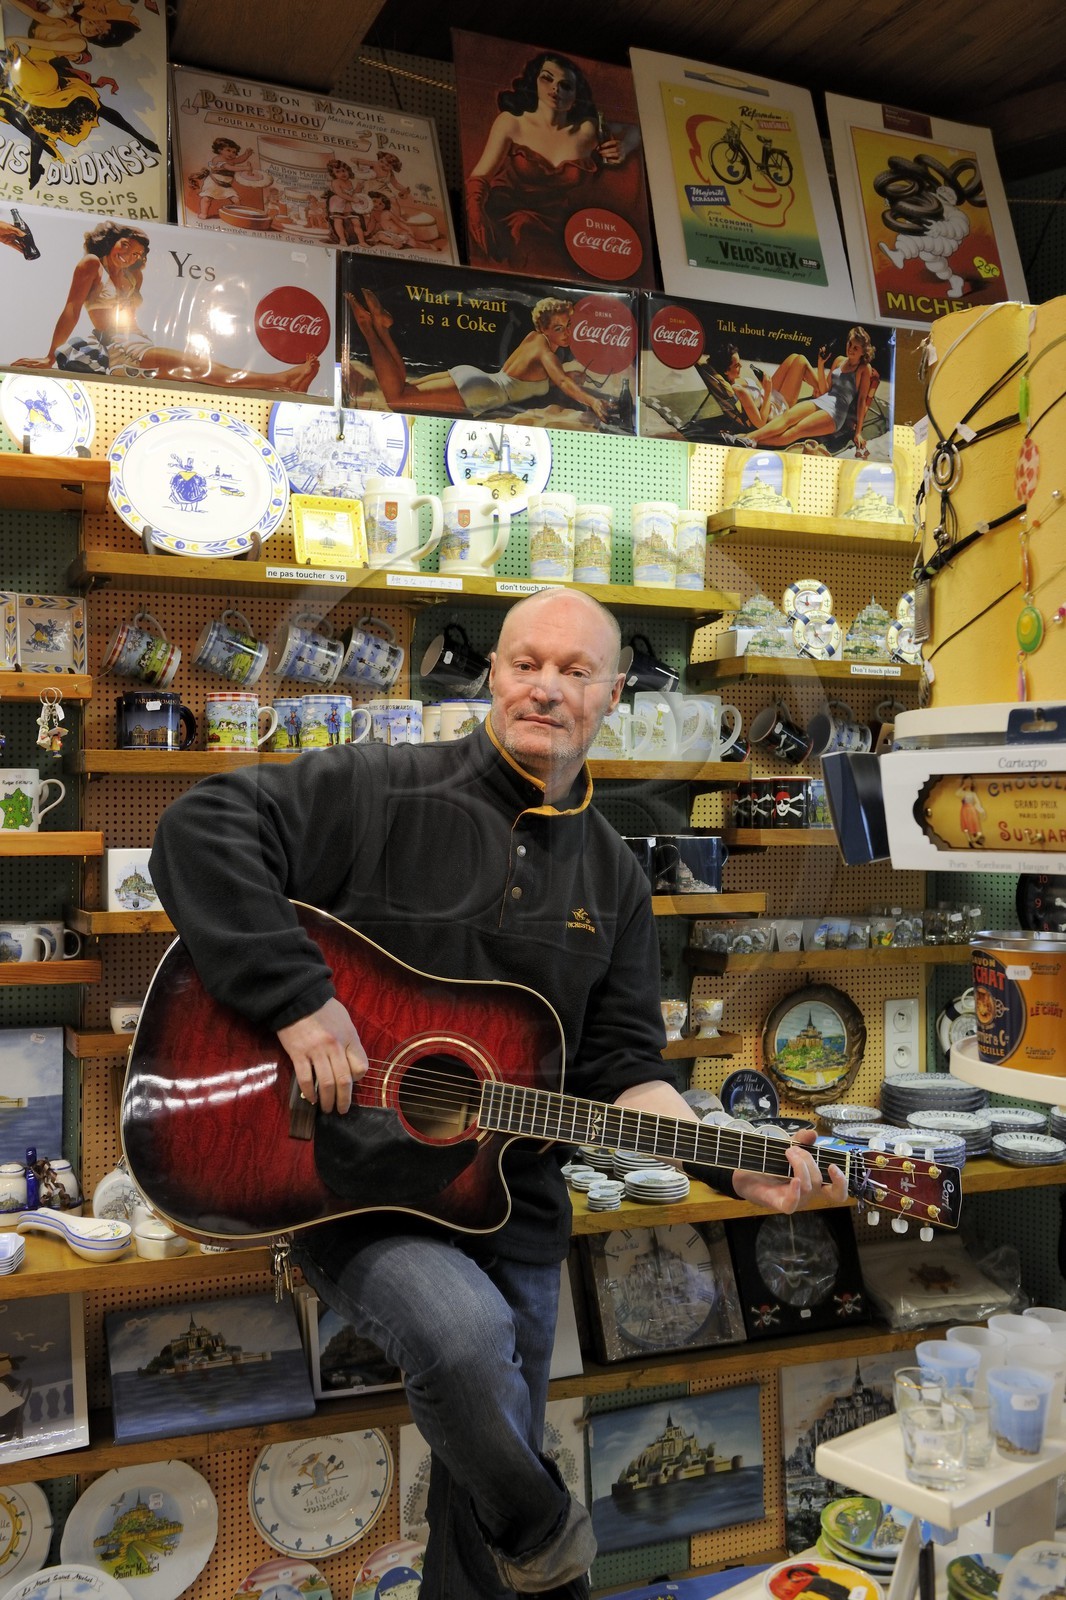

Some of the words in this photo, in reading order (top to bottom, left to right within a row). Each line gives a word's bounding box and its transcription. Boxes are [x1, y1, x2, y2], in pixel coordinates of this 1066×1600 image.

[261, 88, 300, 108] BON
[199, 88, 266, 118] POUDRE
[266, 104, 322, 129] BIJOU
[217, 116, 243, 127] POUR
[245, 121, 256, 129] LA
[259, 124, 298, 137] TOILETTE
[300, 130, 319, 142] DES
[36, 189, 69, 205] les
[79, 189, 139, 207] Soirs
[127, 206, 160, 220] BAL
[586, 218, 617, 233] DRINK
[572, 231, 632, 257] Coca-Cola
[169, 250, 217, 282] Yes
[405, 285, 451, 306] What
[457, 291, 463, 307] I
[469, 296, 508, 313] want
[885, 291, 983, 316] MICHE
[420, 308, 435, 326] is
[441, 317, 451, 327] a
[457, 313, 497, 333] Coke
[594, 311, 613, 319] DRINK
[258, 309, 324, 337] Coca-Cola
[573, 319, 633, 348] Coca-Cola
[653, 324, 700, 348] Coca-Cola
[716, 319, 737, 334] Talk
[739, 323, 766, 337] about
[767, 328, 813, 347] refreshing
[466, 430, 477, 441] 10
[524, 435, 531, 447] 2
[460, 448, 468, 460] 9
[528, 453, 537, 467] 3
[465, 467, 472, 480] 8
[521, 473, 529, 484] 4
[491, 488, 500, 500] 6
[510, 484, 517, 496] 5
[279, 571, 294, 579] pas
[296, 571, 326, 579] toucher
[500, 584, 518, 592] don't
[883, 668, 900, 676] please
[998, 757, 1048, 770] Cartexpo
[1014, 800, 1039, 809] GRAND
[1040, 800, 1058, 809] PRIX
[1034, 897, 1042, 908] 9
[972, 956, 996, 967] AVON
[975, 966, 1006, 991] CHAT
